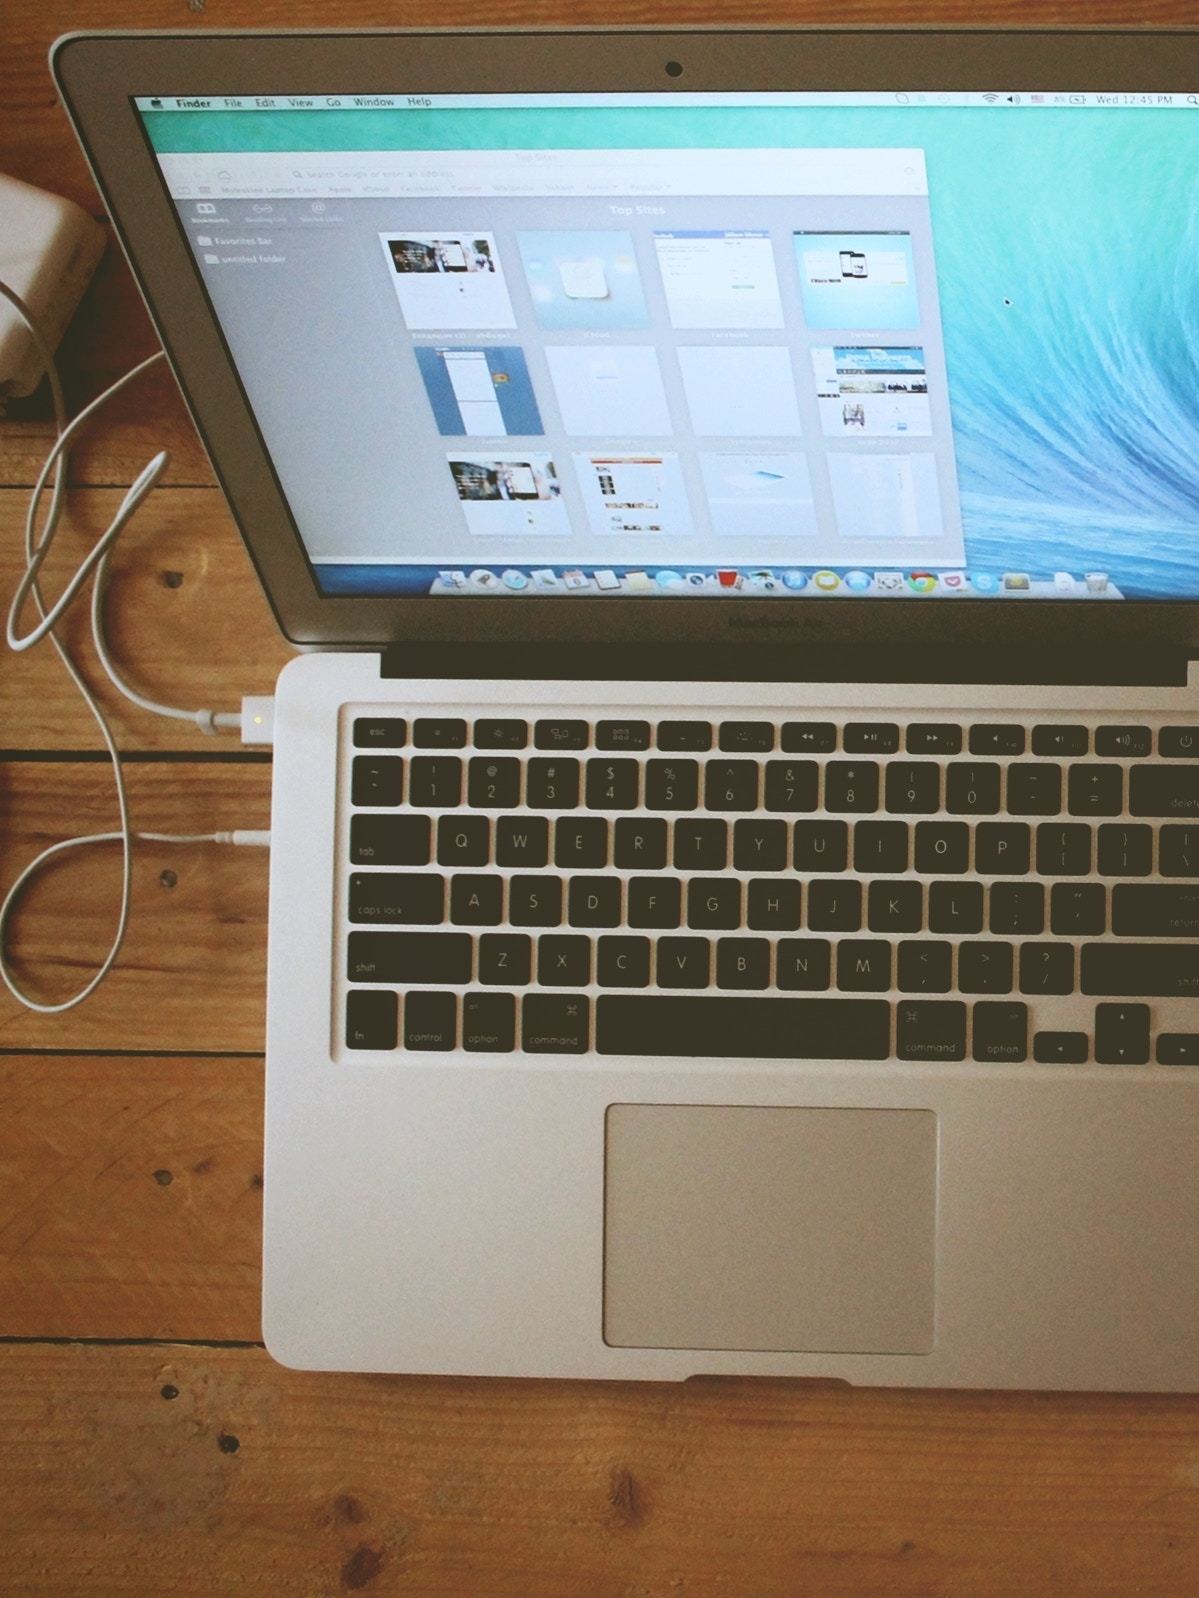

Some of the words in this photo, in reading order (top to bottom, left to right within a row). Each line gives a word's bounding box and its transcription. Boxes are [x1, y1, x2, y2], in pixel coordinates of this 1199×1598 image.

[176, 98, 212, 109] Finder
[224, 98, 243, 108] File
[255, 97, 276, 108] Edit
[288, 97, 313, 108] View
[326, 97, 341, 108] Go
[354, 96, 395, 107] Window
[407, 96, 432, 108] Help
[1096, 95, 1118, 105] Wed
[1123, 95, 1153, 105] 12:45
[1157, 95, 1173, 105] PM
[609, 205, 633, 217] Top
[635, 204, 666, 215] Sites
[220, 255, 256, 265] untitled
[258, 255, 286, 265] folder
[369, 728, 385, 736] esc
[784, 768, 794, 782] &
[487, 785, 496, 798] 2
[546, 785, 556, 798] 3
[605, 785, 614, 798] 4
[665, 787, 674, 800] 5
[725, 788, 734, 801] 6
[785, 788, 794, 800] 7
[847, 789, 855, 802] 8
[907, 790, 916, 802] 9
[967, 790, 977, 804] 0
[455, 834, 468, 848] Q
[512, 834, 528, 848] W
[575, 835, 583, 849] E
[634, 836, 644, 849] R
[695, 837, 702, 850] T
[754, 838, 763, 851] Y
[814, 839, 825, 853] U
[934, 840, 947, 854] O
[998, 840, 1007, 854] P
[359, 847, 375, 857] tab
[468, 894, 480, 907] A
[529, 894, 538, 908] S
[588, 895, 599, 909] D
[649, 896, 656, 909] F
[706, 897, 719, 911] G
[767, 899, 779, 912] H
[830, 900, 836, 913] J
[889, 900, 899, 913] K
[358, 906, 381, 916] caps
[383, 906, 402, 915] lock
[952, 901, 959, 915] L
[498, 952, 508, 967] Z
[557, 954, 567, 968] X
[616, 955, 627, 969] C
[676, 956, 687, 969] V
[737, 956, 747, 971] B
[796, 959, 808, 972] N
[856, 959, 871, 973] M
[355, 963, 376, 973] shift
[1177, 977, 1199, 987] shift
[354, 1031, 365, 1040] fn
[408, 1032, 443, 1042] control
[468, 1034, 499, 1044] option
[529, 1036, 579, 1046] command
[905, 1042, 956, 1053] command
[986, 1043, 1019, 1056] option
